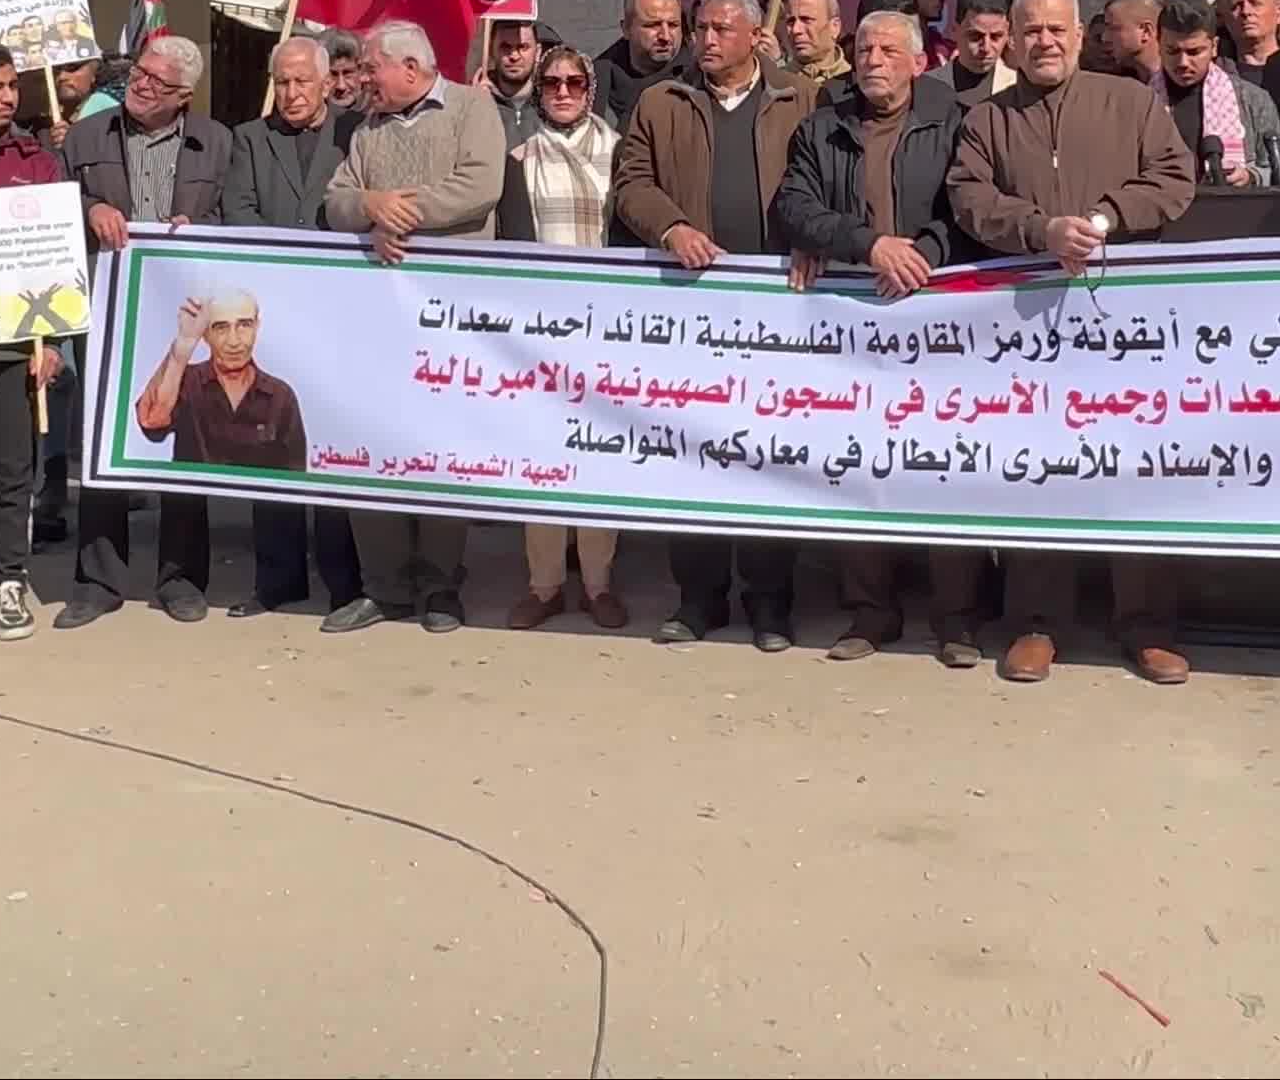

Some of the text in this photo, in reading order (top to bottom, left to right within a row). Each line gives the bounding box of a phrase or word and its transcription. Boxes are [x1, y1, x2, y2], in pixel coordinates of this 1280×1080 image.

[417, 297, 514, 333] سعدات
[522, 302, 593, 339] أحمد
[603, 307, 686, 345] القائد
[695, 314, 856, 360] الفلسطينية
[1067, 307, 1180, 362] أيقونة
[864, 318, 975, 365] المقاومة
[983, 320, 1062, 363] ورمز
[1195, 324, 1232, 364] مع
[414, 349, 588, 404] والامبريالية
[594, 361, 747, 410] الصهيونية
[753, 377, 872, 419] السجون
[934, 371, 1050, 423] الأسرى
[884, 377, 926, 431] في
[1064, 387, 1168, 430] وجميع
[564, 416, 687, 465] المتواصلة
[698, 428, 810, 471] معاركهم
[822, 433, 863, 487] في
[871, 431, 993, 483] الأبطال
[1001, 433, 1122, 486] للأسرى
[309, 444, 578, 488] الجبهة الشعبية لتحرير فلسطين
[1136, 440, 1274, 489] والإسناد
